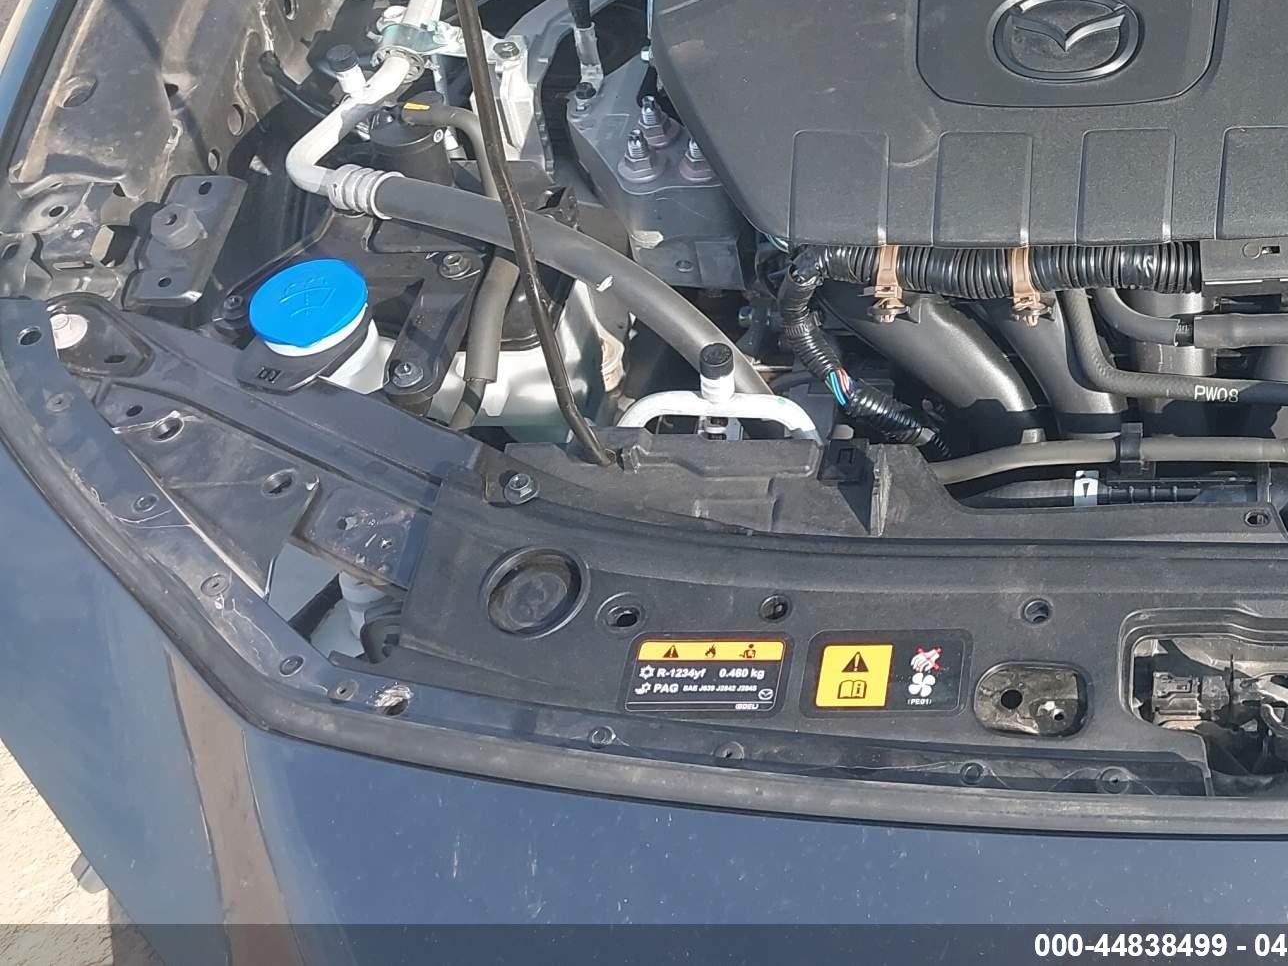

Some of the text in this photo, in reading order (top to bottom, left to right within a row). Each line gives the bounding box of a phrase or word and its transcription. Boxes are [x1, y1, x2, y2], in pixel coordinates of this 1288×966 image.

[1193, 384, 1240, 403] PW08
[656, 668, 707, 680] R-1234yf
[750, 667, 765, 680] kg
[652, 683, 679, 693] PAG
